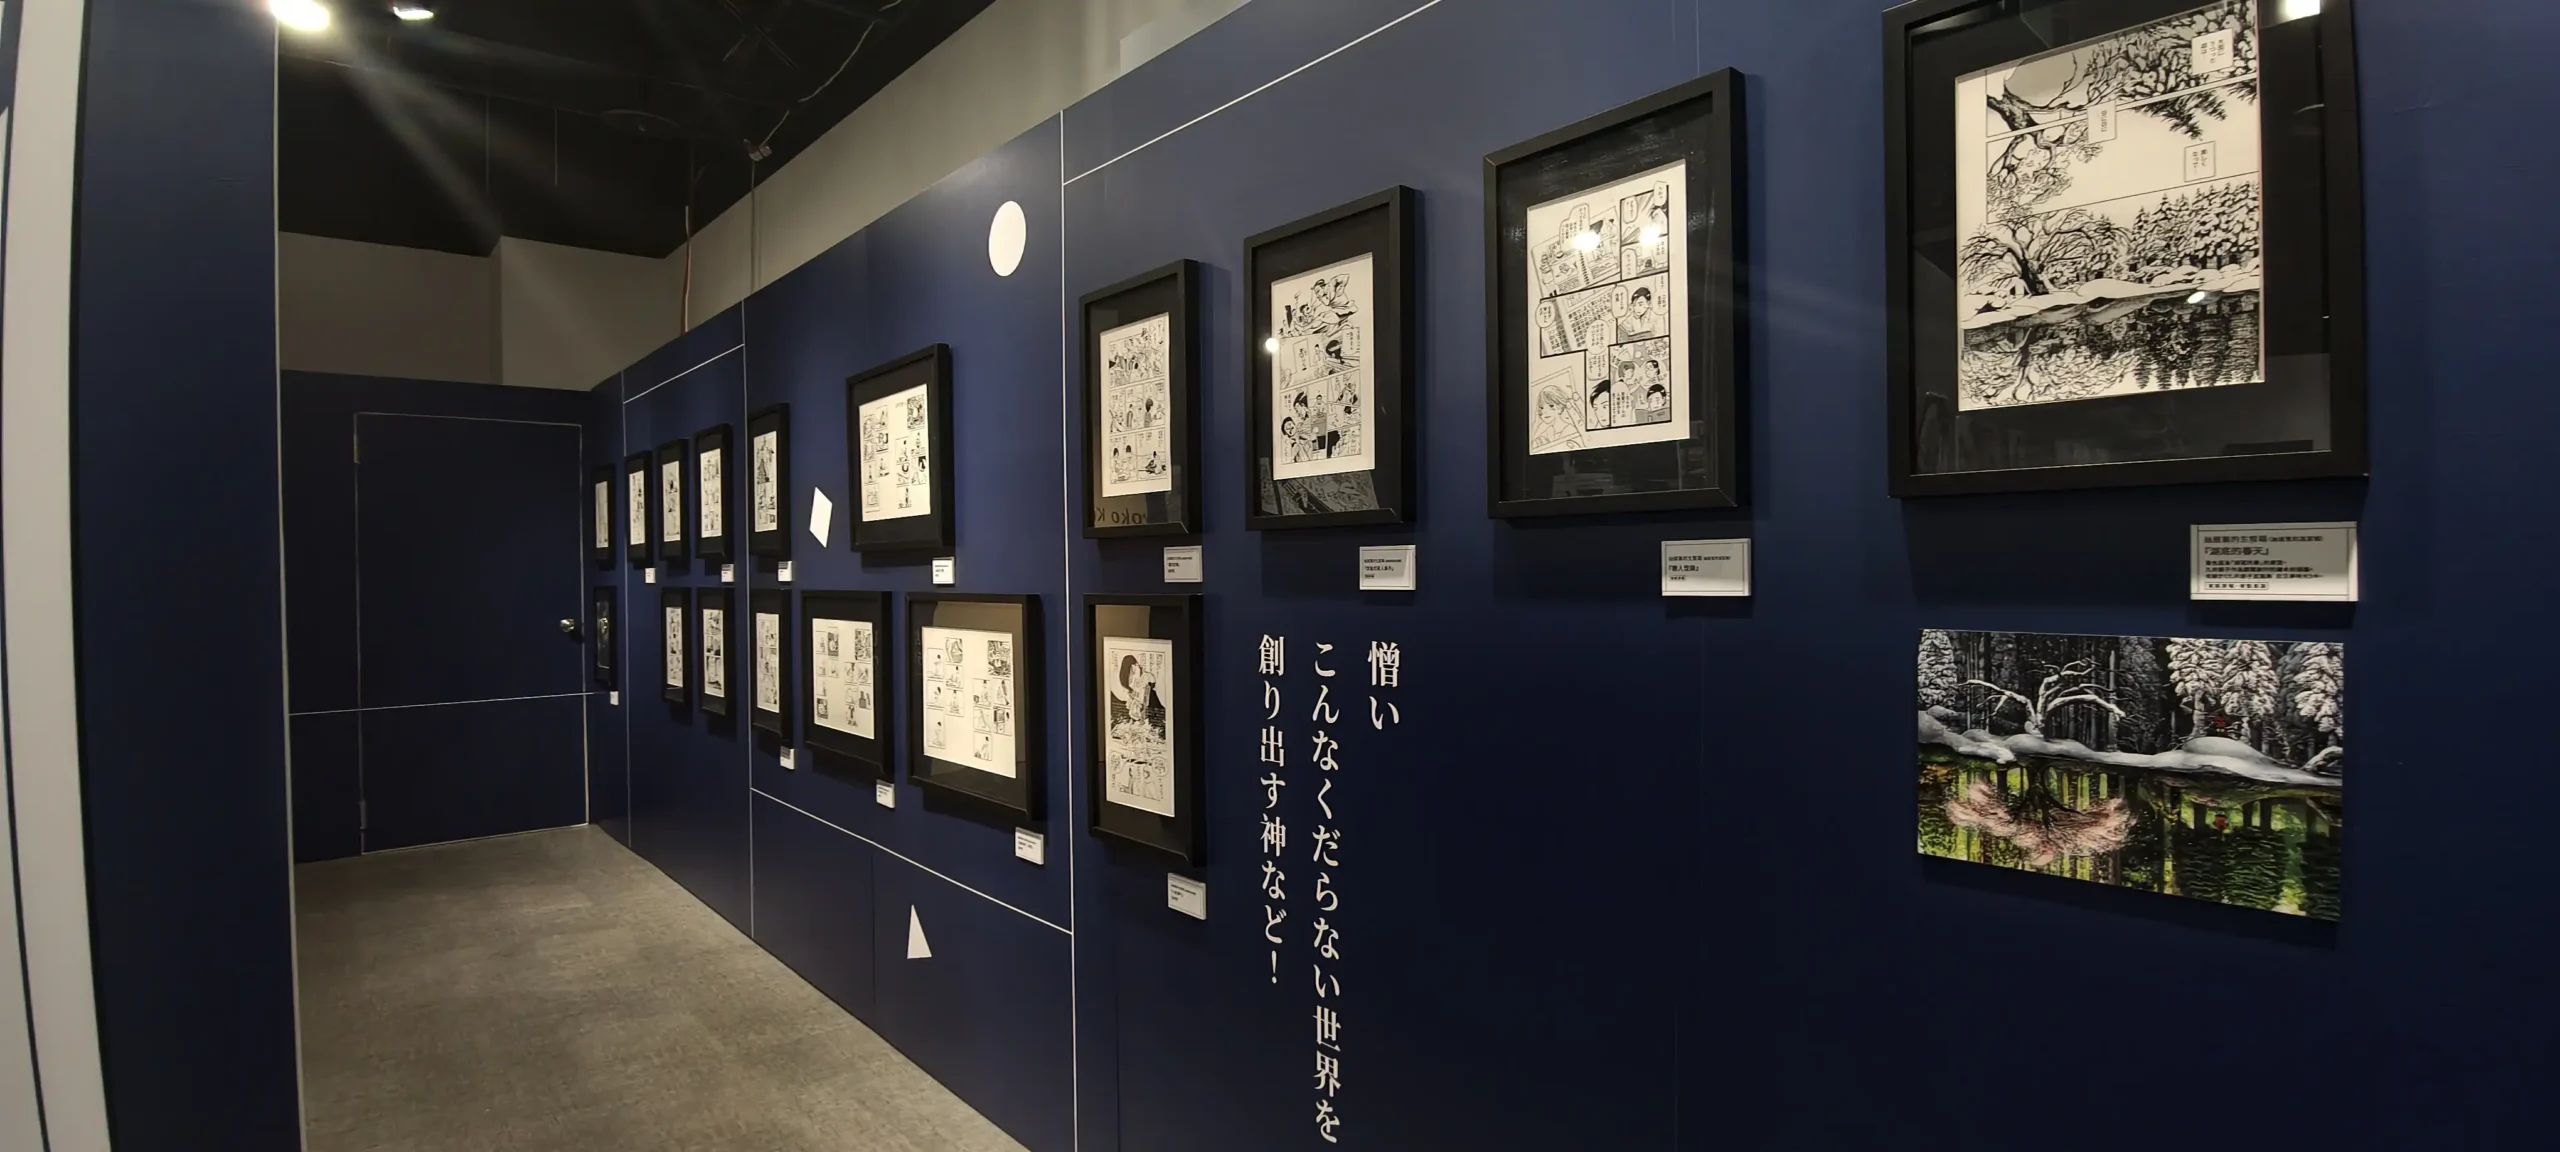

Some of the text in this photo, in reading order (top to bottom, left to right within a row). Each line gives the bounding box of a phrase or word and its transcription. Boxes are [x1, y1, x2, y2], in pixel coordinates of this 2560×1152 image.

[1368, 640, 1401, 730] 憎い
[1311, 642, 1342, 1144] こんなくだらない世界を
